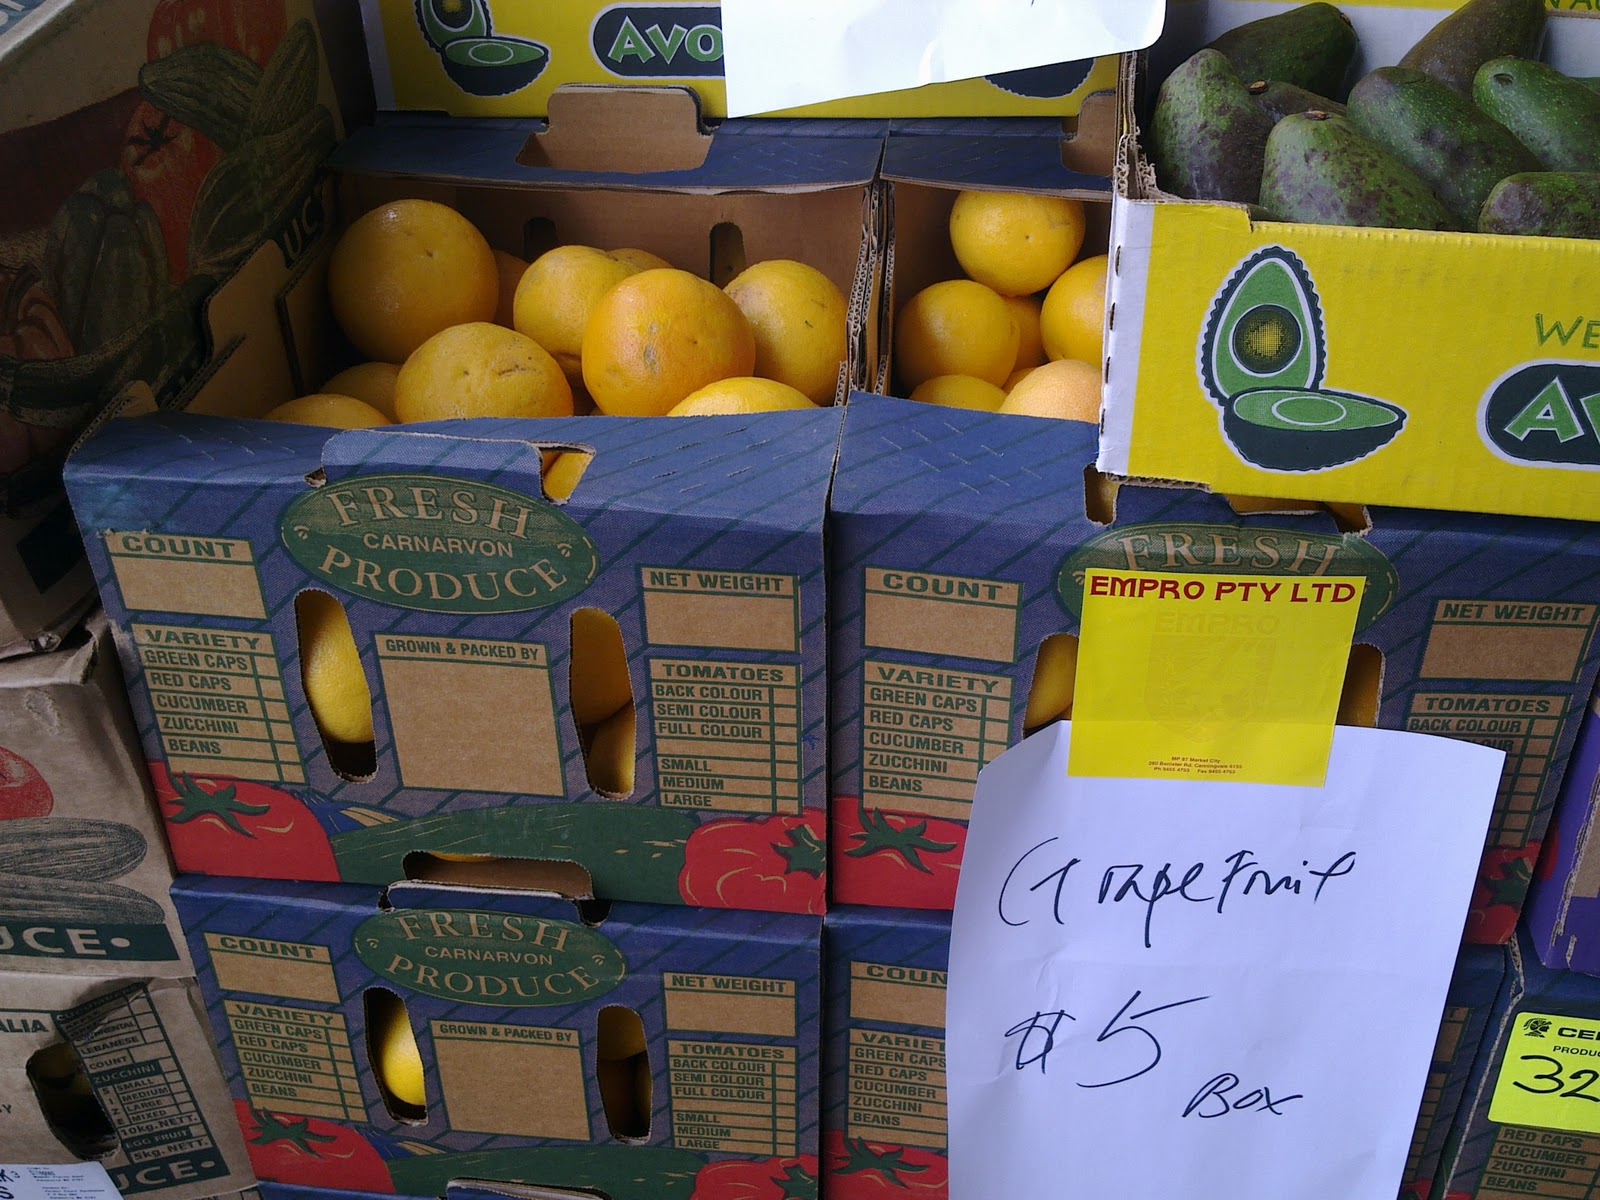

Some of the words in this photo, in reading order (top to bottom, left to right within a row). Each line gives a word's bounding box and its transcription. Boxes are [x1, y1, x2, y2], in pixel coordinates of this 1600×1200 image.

[325, 485, 534, 539] FRESH
[121, 535, 235, 558] COUNT
[363, 533, 514, 558] CARNARVON
[1117, 531, 1343, 576] FRESH
[318, 544, 567, 601] PRODUCE
[650, 571, 691, 587] NET
[697, 573, 784, 592] WEIGHT
[883, 573, 1003, 600] COUNT
[1089, 575, 1205, 600] EMPRO
[1213, 581, 1281, 602] PTY
[1289, 583, 1356, 603] LTD
[1442, 603, 1488, 618] NET
[1494, 604, 1585, 621] WEIGHT
[145, 629, 260, 650] VARIETY
[386, 639, 441, 654] GROWN
[446, 640, 456, 655] &
[461, 643, 516, 659] PACKED
[521, 647, 539, 661] BY
[144, 650, 200, 667] GREEN
[204, 654, 248, 671] CAPS
[151, 672, 184, 687] RED
[188, 675, 232, 691] CAPS
[662, 664, 784, 682] TOMATOES
[878, 666, 1000, 693] VARIETY
[655, 684, 695, 697] BACK
[700, 687, 762, 701] COLOUR
[870, 687, 927, 706] GREEN
[932, 694, 977, 712] CAPS
[156, 694, 249, 714] CUCUMBER
[657, 703, 694, 717] SEMI
[699, 705, 761, 720] COLOUR
[1424, 697, 1550, 713] TOMATOES
[161, 716, 240, 734] ZUCCHINI
[870, 710, 903, 725] RED
[909, 714, 953, 731] CAPS
[1409, 718, 1452, 731] BACK
[1456, 719, 1522, 732] COLOUR
[658, 722, 696, 735] FULL
[701, 724, 762, 738] COLOUR
[168, 738, 222, 754] BEANS
[869, 731, 964, 754] CUCUMBER
[661, 758, 712, 772] SMALL
[868, 753, 948, 773] ZUCCHINI
[663, 776, 724, 790] MEDIUM
[869, 775, 923, 792] BEANS
[664, 794, 712, 807] LARGE
[395, 911, 572, 952] FRESH
[220, 937, 316, 959] COUNT
[424, 946, 553, 966] CARNARVON
[385, 954, 600, 997] PRODUCE
[672, 975, 707, 988] NET
[712, 977, 787, 993] WEIGHT
[235, 1004, 334, 1025] VARIETY
[234, 1019, 281, 1035] GREEN
[285, 1026, 323, 1040] CAPS
[439, 1023, 490, 1036] GROWN
[492, 1026, 501, 1037] &
[504, 1028, 552, 1041] PACKED
[555, 1032, 572, 1042] BY
[80, 1035, 140, 1055] LEBANESE
[238, 1035, 267, 1048] RED
[271, 1039, 308, 1053] CAPS
[679, 1043, 785, 1059] TOMATOES
[89, 1055, 129, 1070] COUNT
[243, 1051, 322, 1070] CUCUMBER
[673, 1059, 707, 1069] BACK
[711, 1061, 766, 1072] COLOUR
[855, 1047, 904, 1062] GREEN
[909, 1054, 946, 1068] CAPS
[92, 1064, 156, 1084] ZUCCHINI
[247, 1067, 312, 1084] ZUCCHINI
[674, 1072, 706, 1083] SEMI
[710, 1074, 765, 1087] COLOUR
[854, 1065, 884, 1076] RED
[889, 1068, 927, 1081] CAPS
[117, 1078, 155, 1092] SMALL
[121, 1086, 169, 1102] MEDIUM
[252, 1083, 297, 1097] BEANS
[675, 1086, 707, 1096] FULL
[711, 1088, 765, 1100] COLOUR
[854, 1080, 937, 1099] CUCUMBER
[853, 1096, 922, 1113] ZUCCHINI
[1183, 1073, 1304, 1118] Box
[126, 1100, 163, 1112] LARGE
[131, 1109, 167, 1122] MIXED
[676, 1113, 720, 1124] SMALL
[853, 1112, 900, 1126] BEANS
[677, 1126, 731, 1137] MEDIUM
[1503, 1128, 1537, 1139] RED
[1541, 1134, 1583, 1148] CAPS
[678, 1139, 720, 1149] LARGE
[1498, 1144, 1587, 1165] CUCUMBER
[1491, 1160, 1567, 1178] ZUCCHINI
[1486, 1176, 1537, 1191] BEANS
